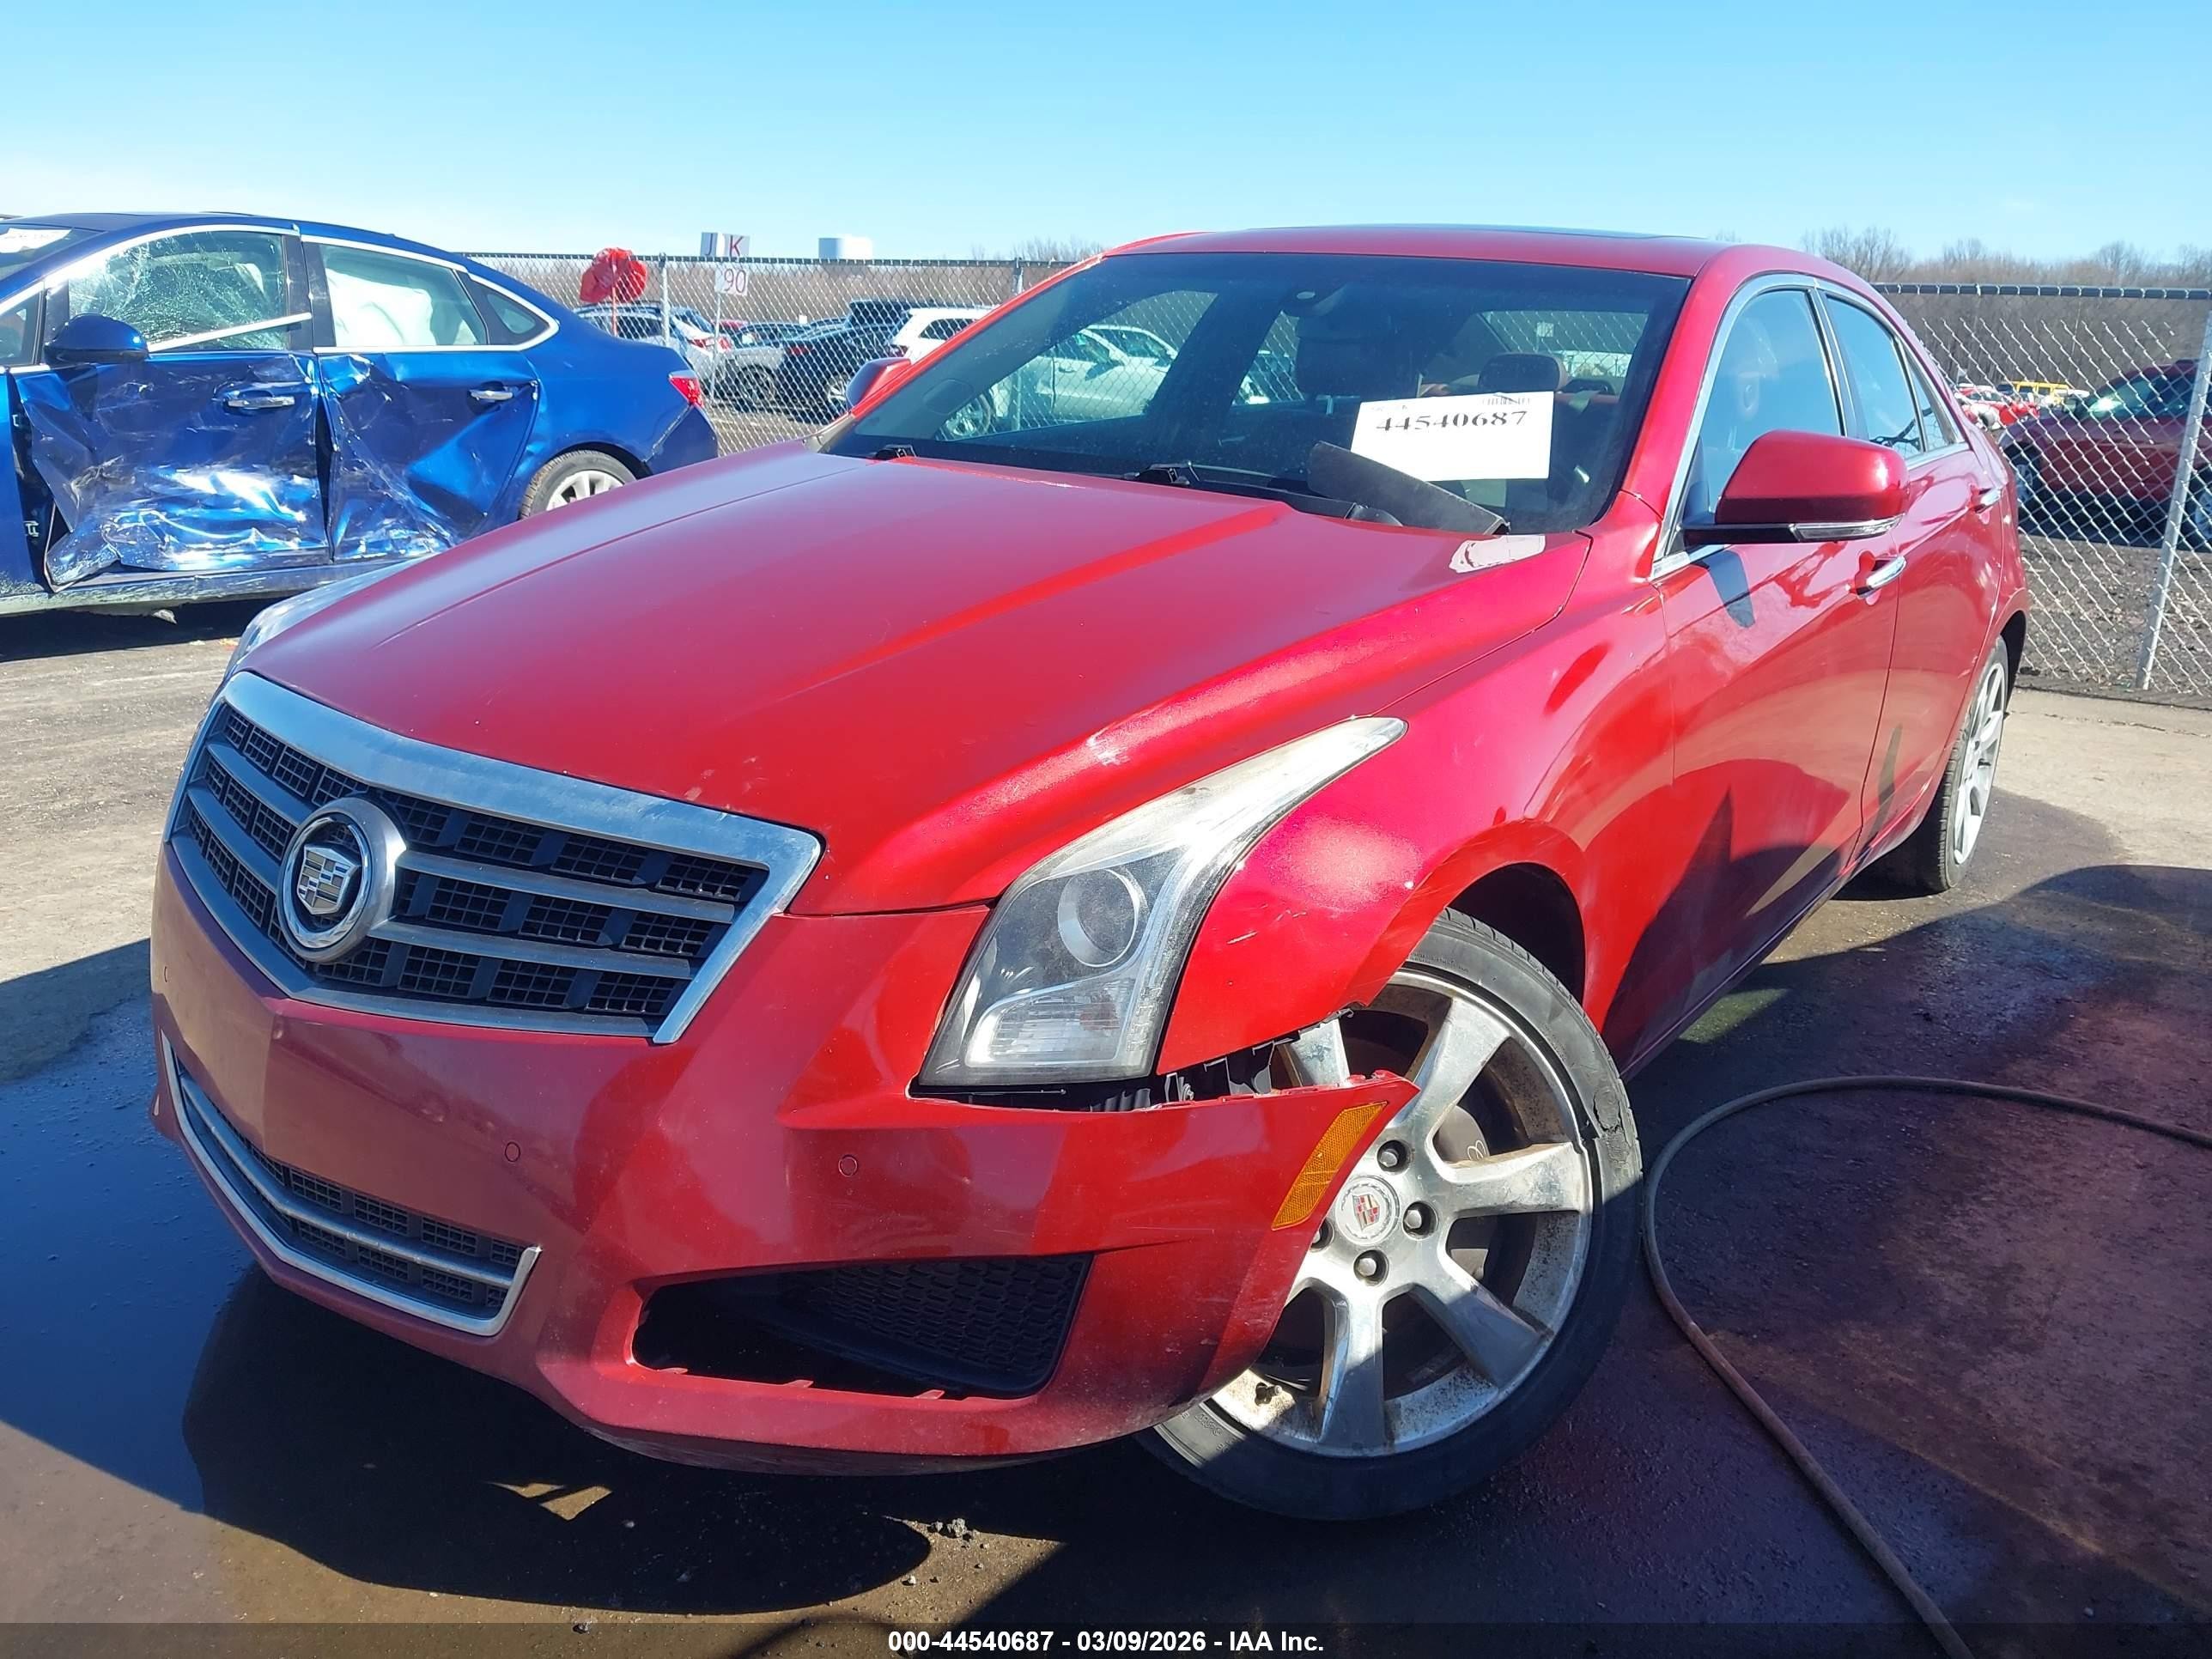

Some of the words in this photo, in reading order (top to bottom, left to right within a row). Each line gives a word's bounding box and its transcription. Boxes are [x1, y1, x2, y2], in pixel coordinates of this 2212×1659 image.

[704, 233, 714, 256] J
[729, 234, 744, 258] K
[723, 267, 746, 294] 90
[1376, 410, 1528, 432] 44540687
